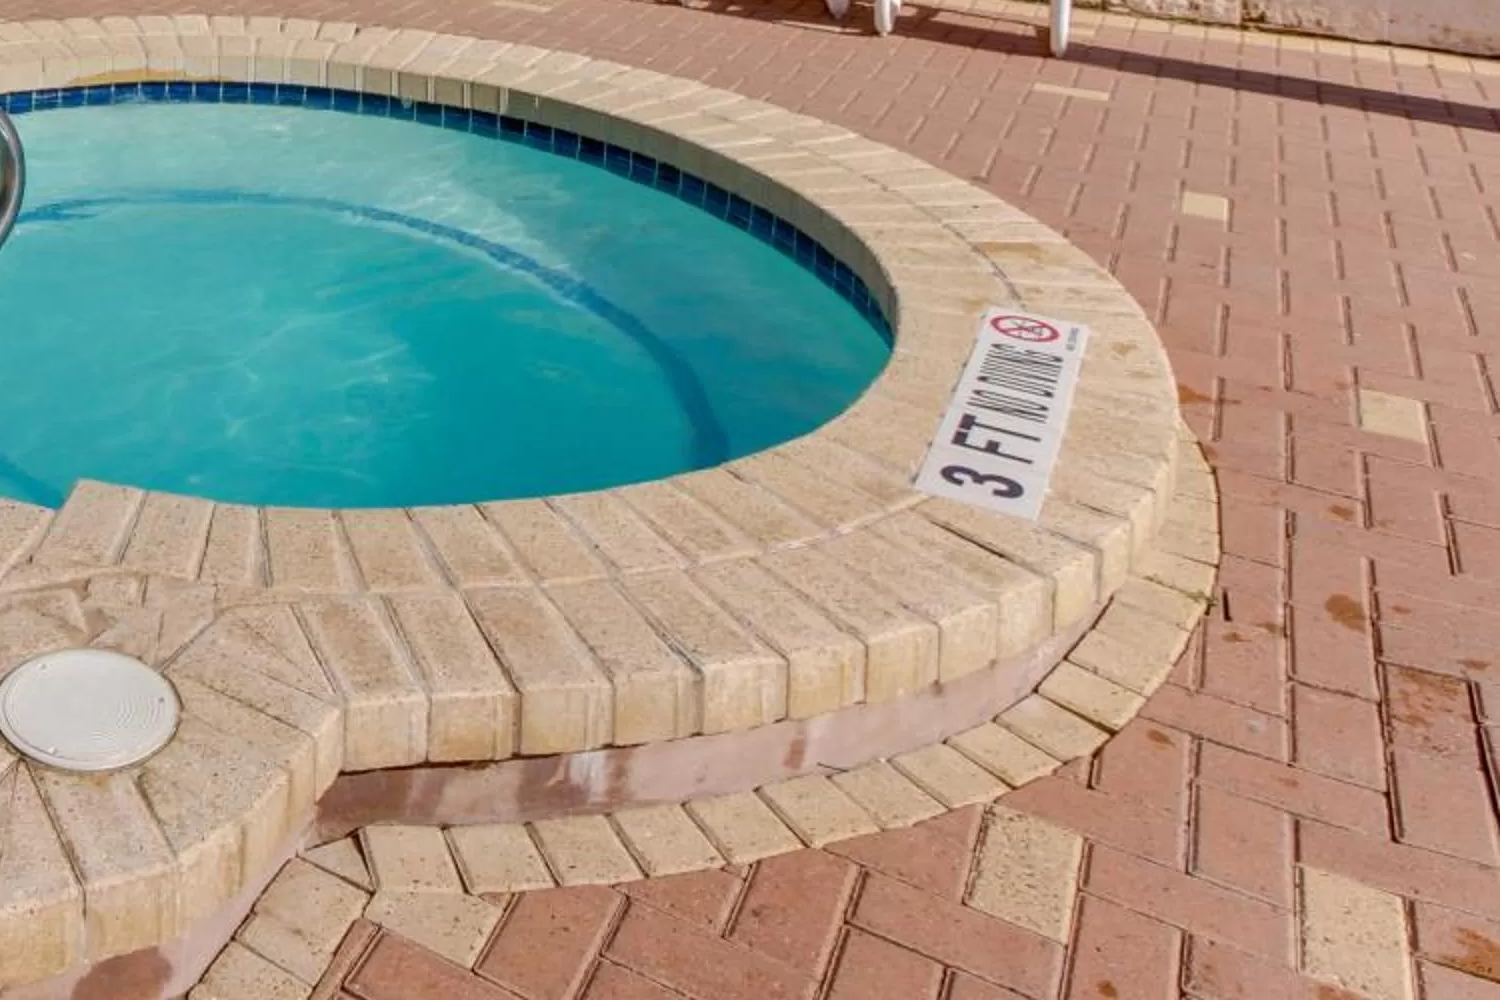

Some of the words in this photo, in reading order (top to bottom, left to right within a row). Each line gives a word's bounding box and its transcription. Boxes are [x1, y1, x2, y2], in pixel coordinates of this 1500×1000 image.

[975, 343, 1064, 399] DIVING
[966, 389, 1050, 424] NO
[951, 413, 1042, 465] FT
[940, 464, 1025, 500] 3
